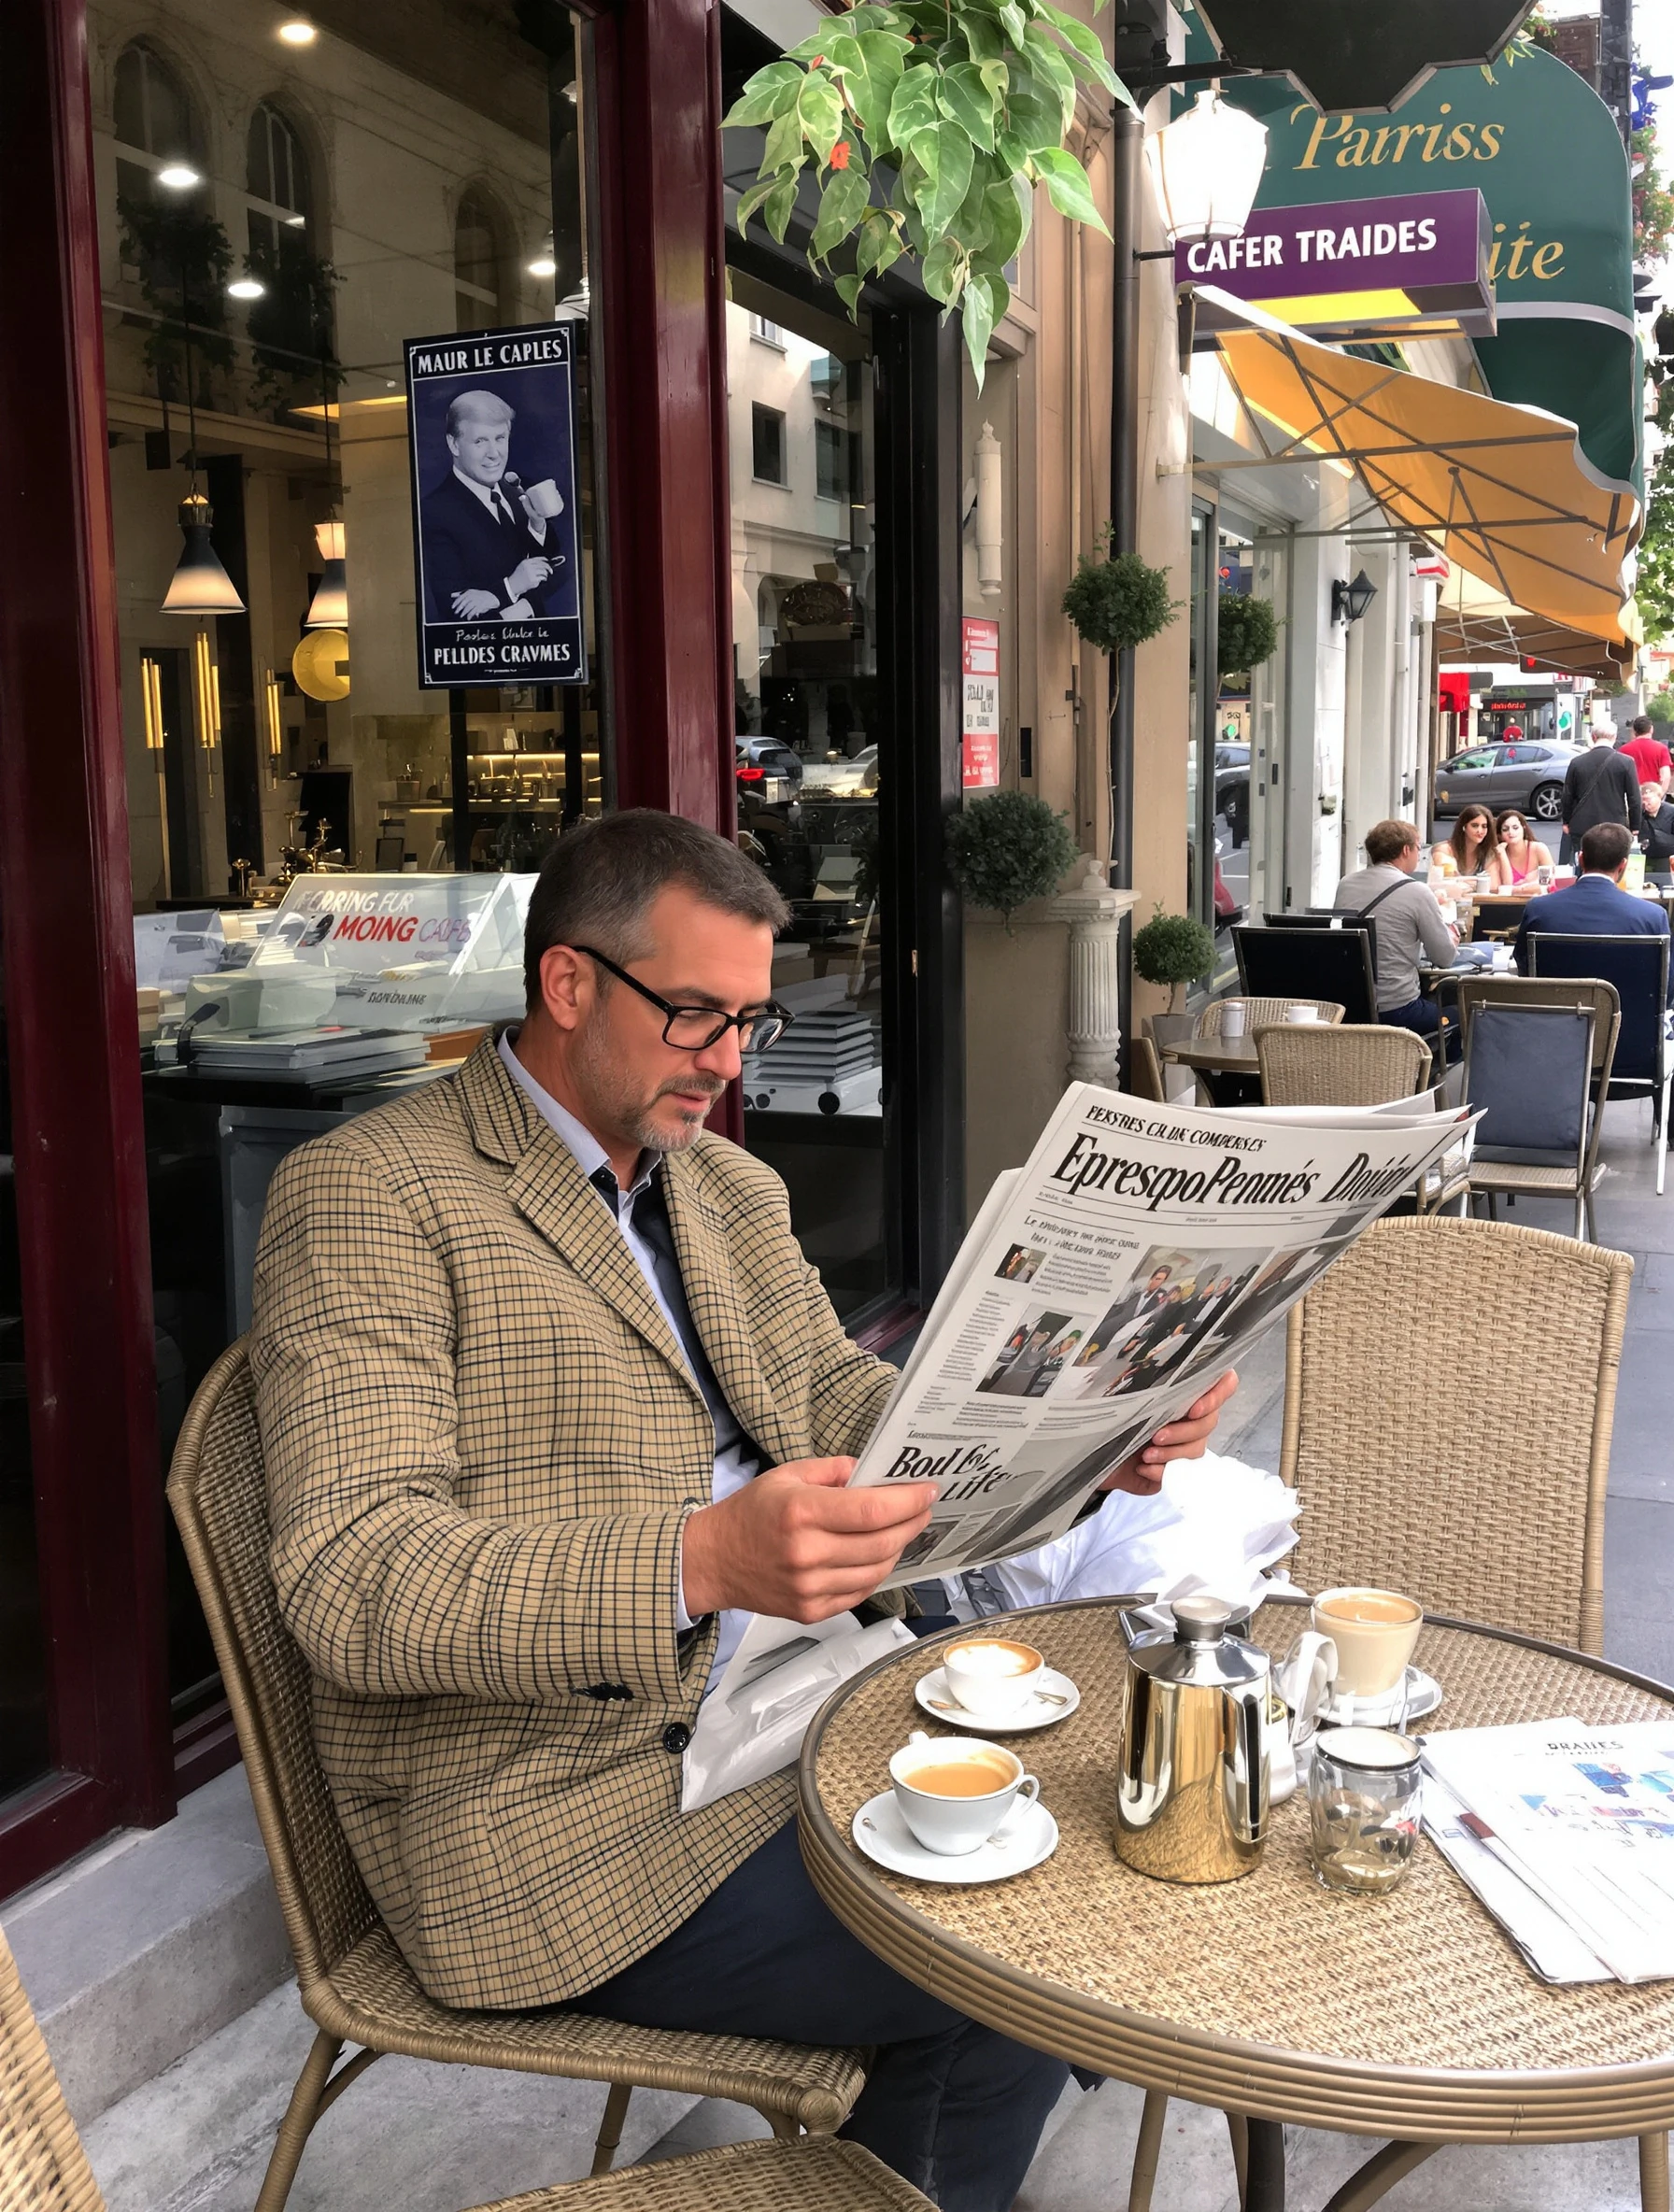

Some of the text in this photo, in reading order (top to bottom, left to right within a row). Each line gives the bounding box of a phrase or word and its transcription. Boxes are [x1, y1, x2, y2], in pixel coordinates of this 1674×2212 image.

[1186, 218, 1437, 274] CAFER TRAIDES
[1488, 221, 1566, 281] ite
[418, 339, 562, 374] MAUR LE CAPLES
[433, 645, 495, 665] PELLDES
[333, 915, 418, 942] MOING
